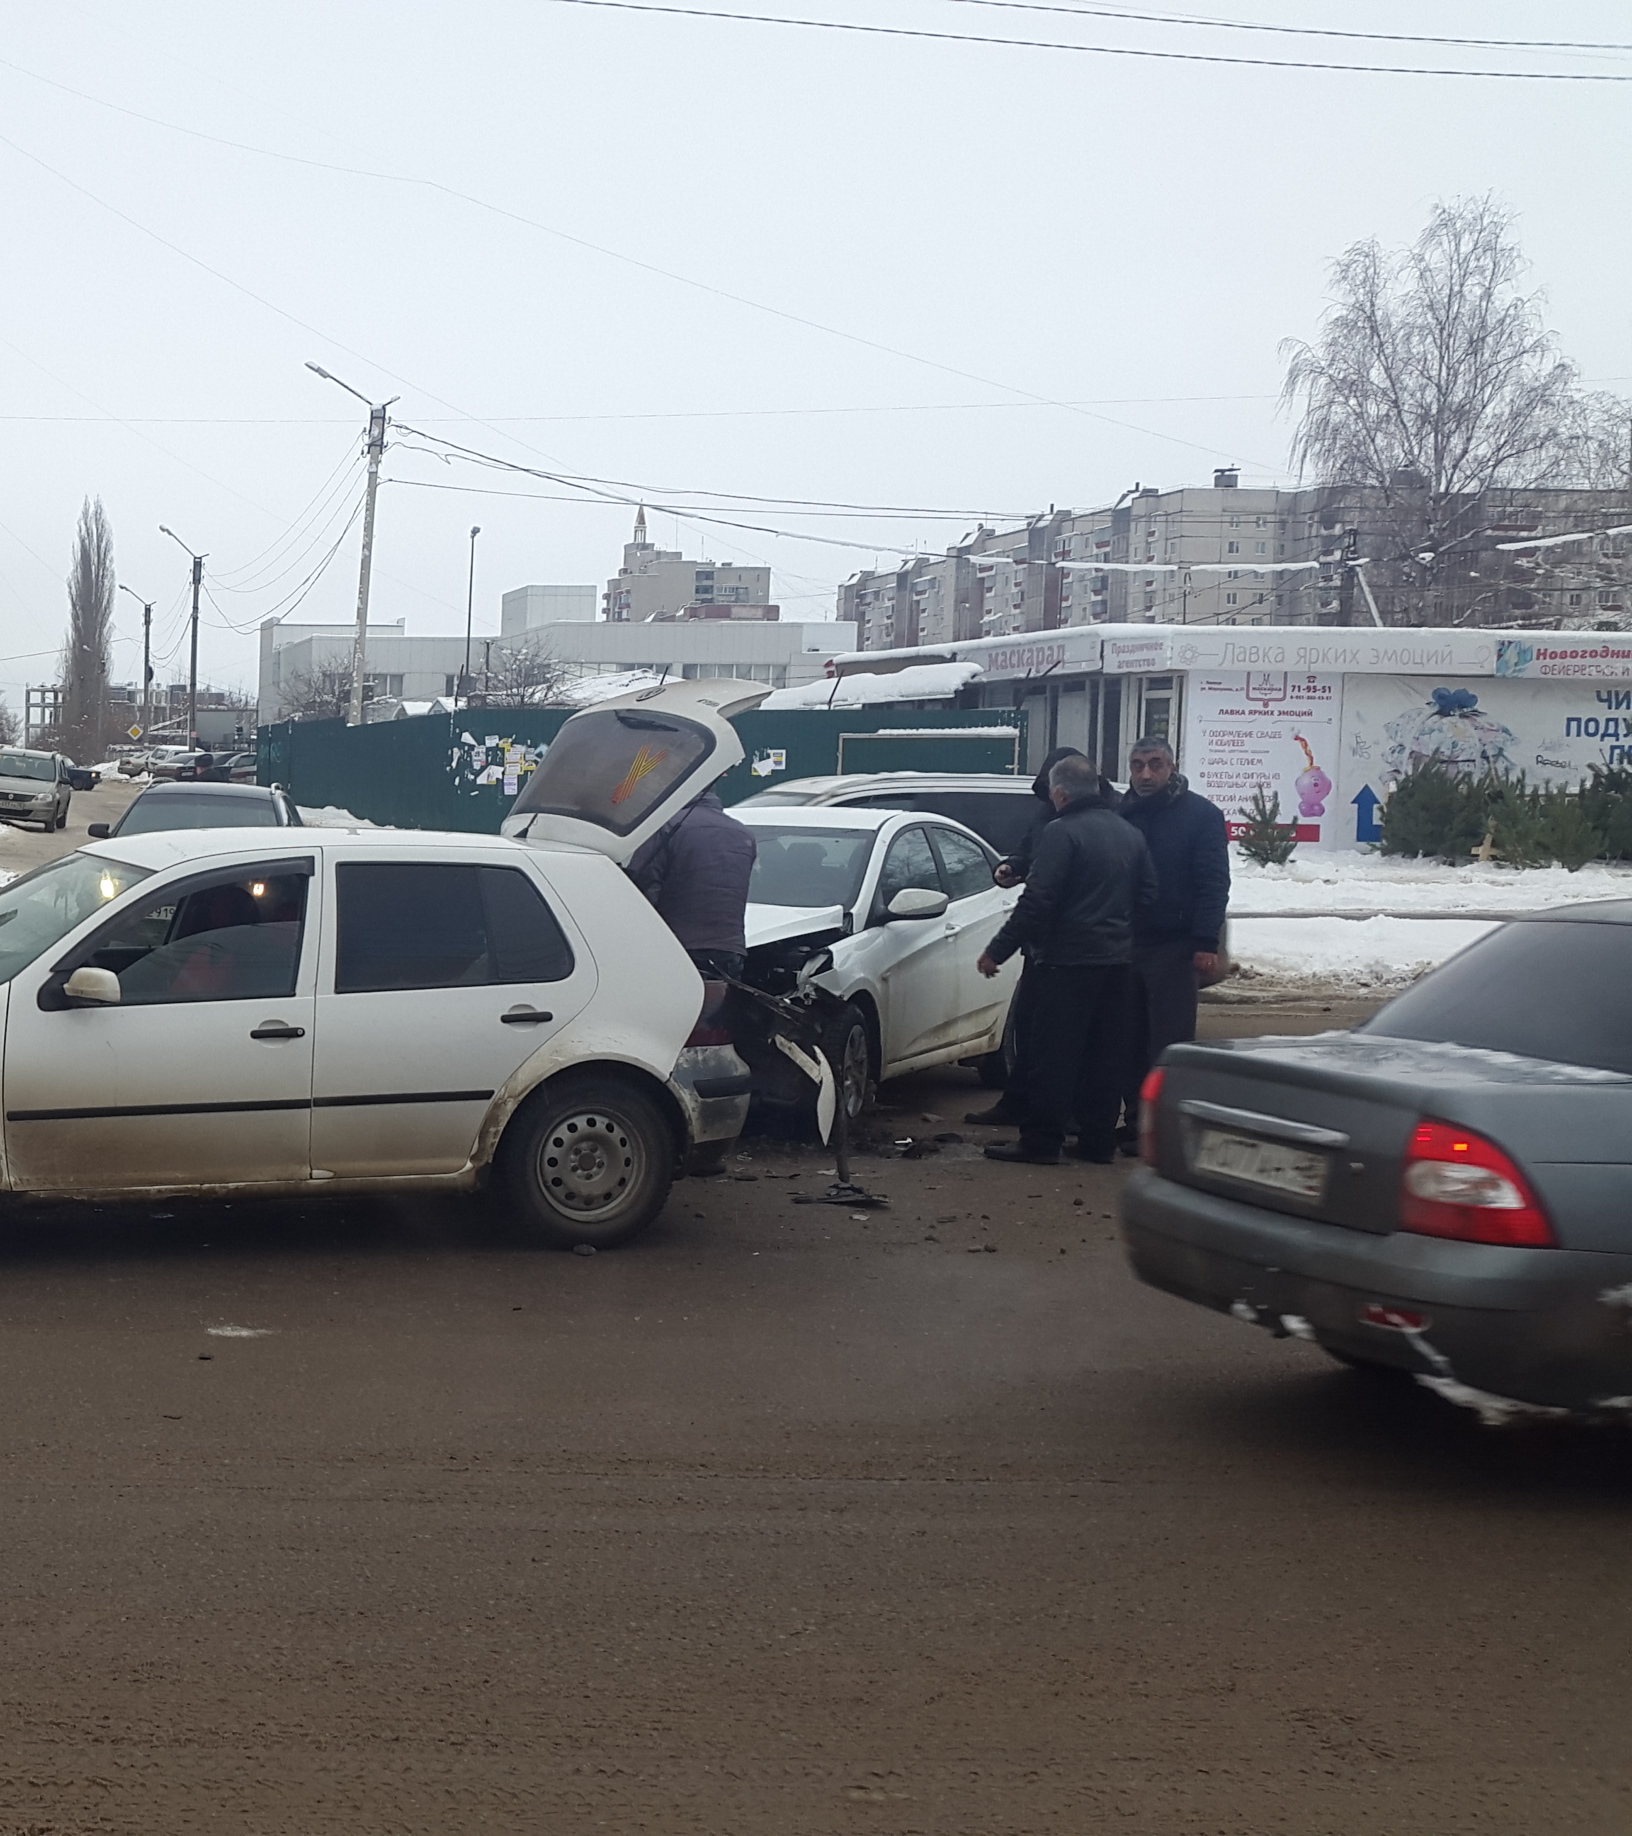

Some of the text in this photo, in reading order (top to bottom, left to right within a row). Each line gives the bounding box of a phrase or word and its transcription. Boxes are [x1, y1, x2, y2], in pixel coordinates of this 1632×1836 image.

[1111, 641, 1165, 656] Праздничное
[1535, 645, 1632, 661] Новогодни
[988, 643, 1066, 675] маскарад
[1218, 642, 1455, 672] Лавка ярких эмоций
[1116, 657, 1157, 669] агентство
[1291, 684, 1332, 694] 71-95-51
[1596, 689, 1631, 710] ЧИ
[1277, 708, 1313, 717] ЭМОЦИЙ
[1209, 730, 1282, 739] ОФОРМЛЕНИЕ СВАДЕБ
[1215, 739, 1245, 747] ЮБИЛЕЕВ
[1208, 758, 1228, 766] ШАРЫ
[1236, 758, 1263, 766] ГЕЛИЕМ
[1206, 772, 1234, 780] БУКЕТЫ
[1242, 772, 1271, 780] ФИГУРЫ
[1206, 780, 1247, 789] ВОЗДУШНЫХ
